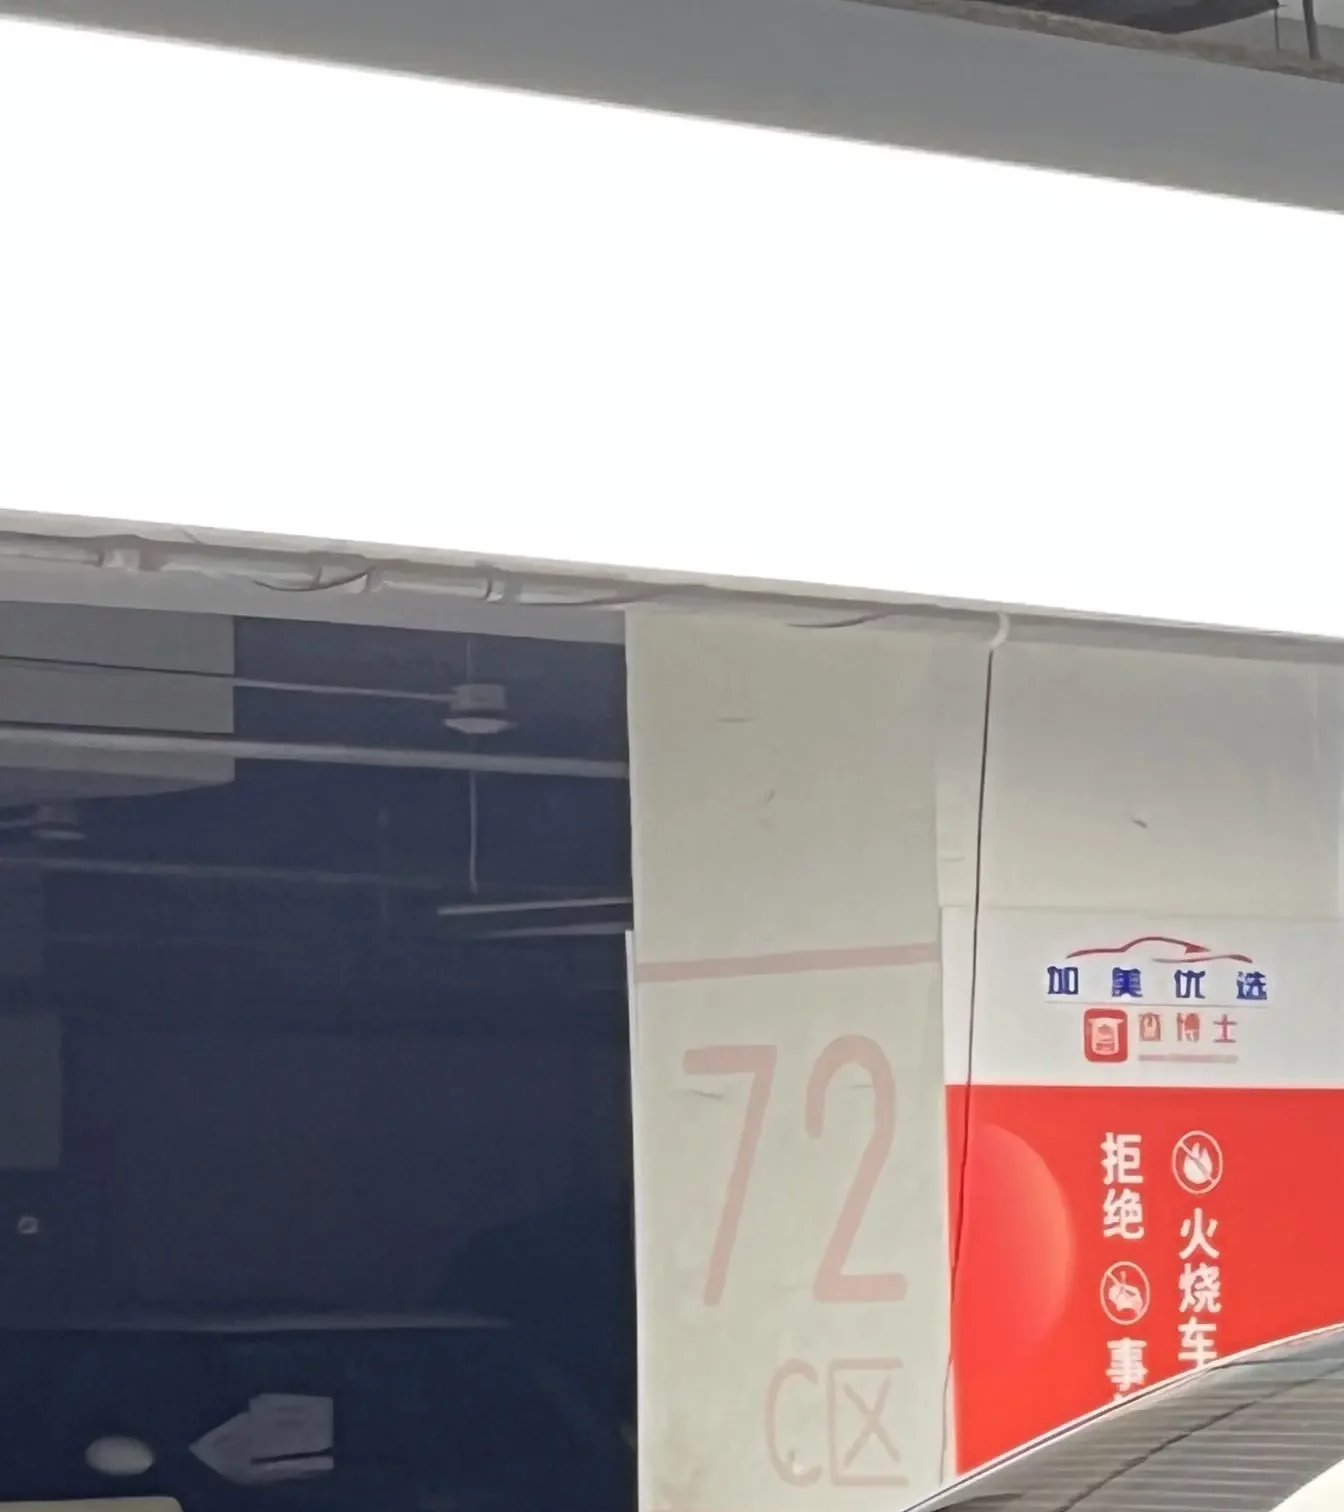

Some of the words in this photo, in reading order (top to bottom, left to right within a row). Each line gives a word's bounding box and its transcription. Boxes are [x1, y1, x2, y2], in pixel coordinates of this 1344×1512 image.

[1047, 966, 1268, 1000] 加美优选
[682, 1034, 907, 1305] 72
[1101, 1131, 1145, 1240] 拒绝
[1178, 1207, 1222, 1369] 火烧车
[764, 1358, 909, 1487] C区
[1106, 1337, 1148, 1402] 事
